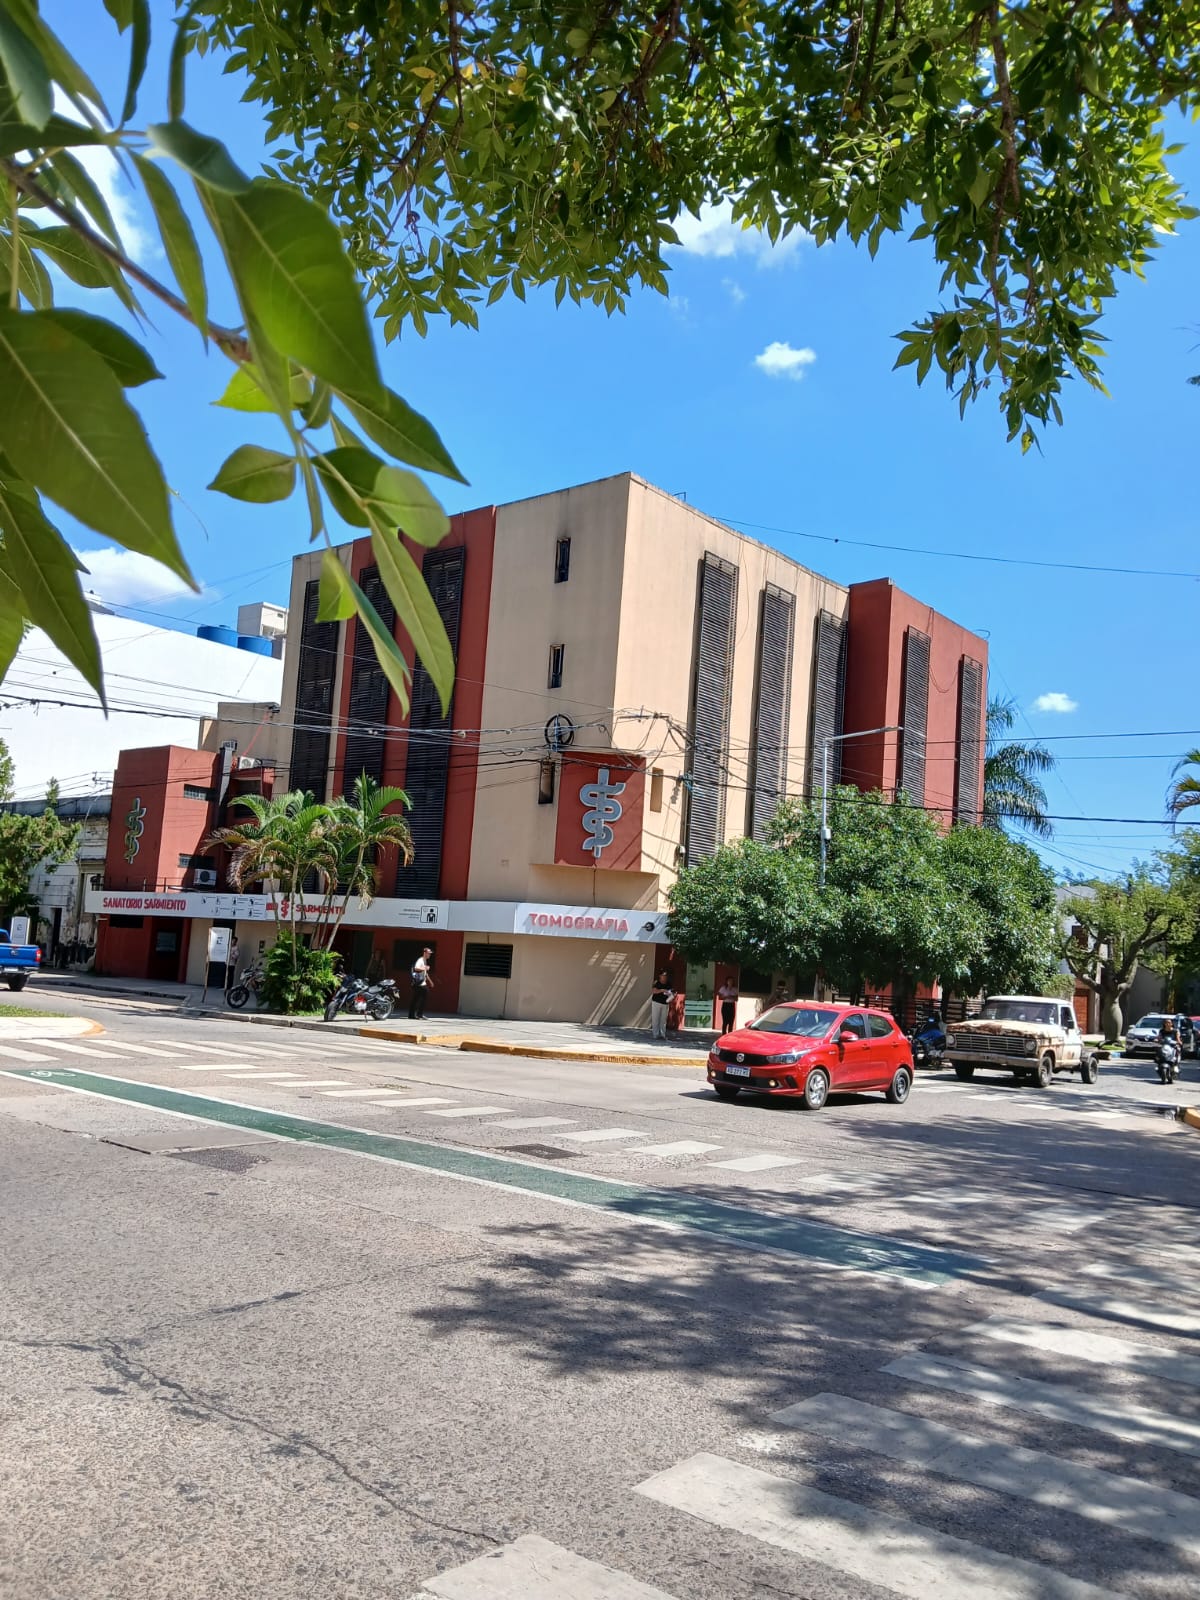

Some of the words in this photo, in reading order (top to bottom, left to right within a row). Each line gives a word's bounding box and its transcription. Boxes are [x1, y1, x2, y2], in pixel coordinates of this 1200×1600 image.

[103, 897, 142, 909] SANATORIO
[144, 898, 186, 911] SARMIENTO
[528, 913, 628, 932] TOMOGRAFIA
